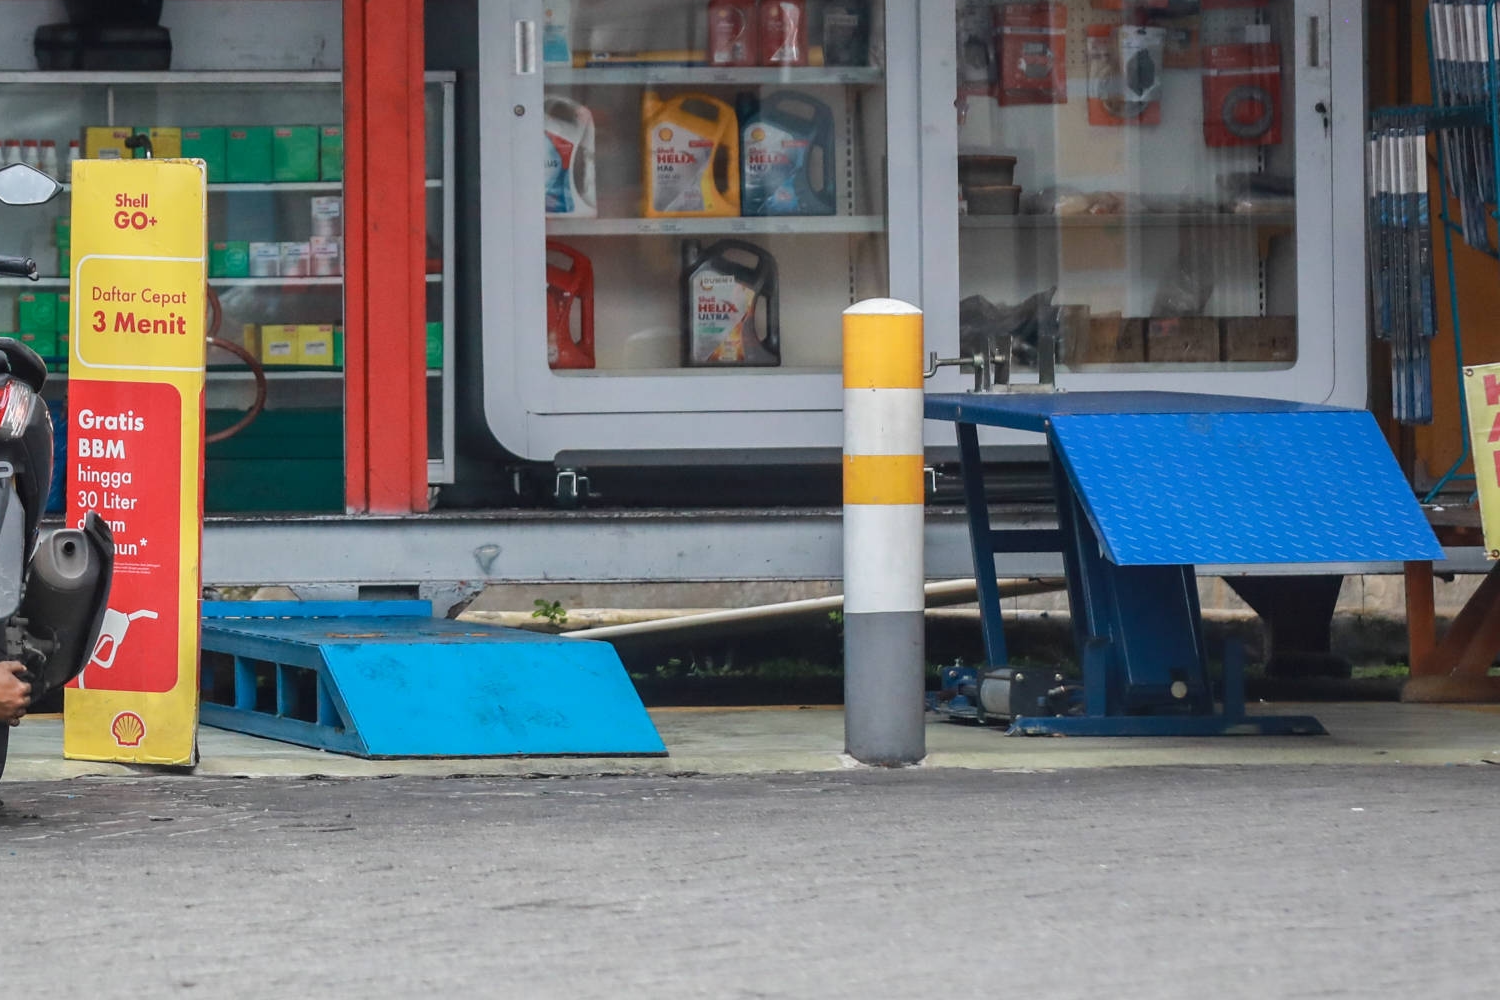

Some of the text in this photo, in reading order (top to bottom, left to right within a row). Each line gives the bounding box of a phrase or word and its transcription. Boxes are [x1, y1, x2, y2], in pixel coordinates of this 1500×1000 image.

[657, 154, 697, 164] HELIX
[115, 193, 149, 208] Shell
[114, 211, 158, 230] GO+
[92, 286, 187, 307] Daftar Cepat
[698, 303, 739, 313] HELIX
[92, 310, 186, 335] 3 Menit
[78, 408, 145, 432] Gratis
[78, 438, 125, 459] BBM
[77, 464, 132, 488] hingga
[77, 490, 138, 510] 30 Liter
